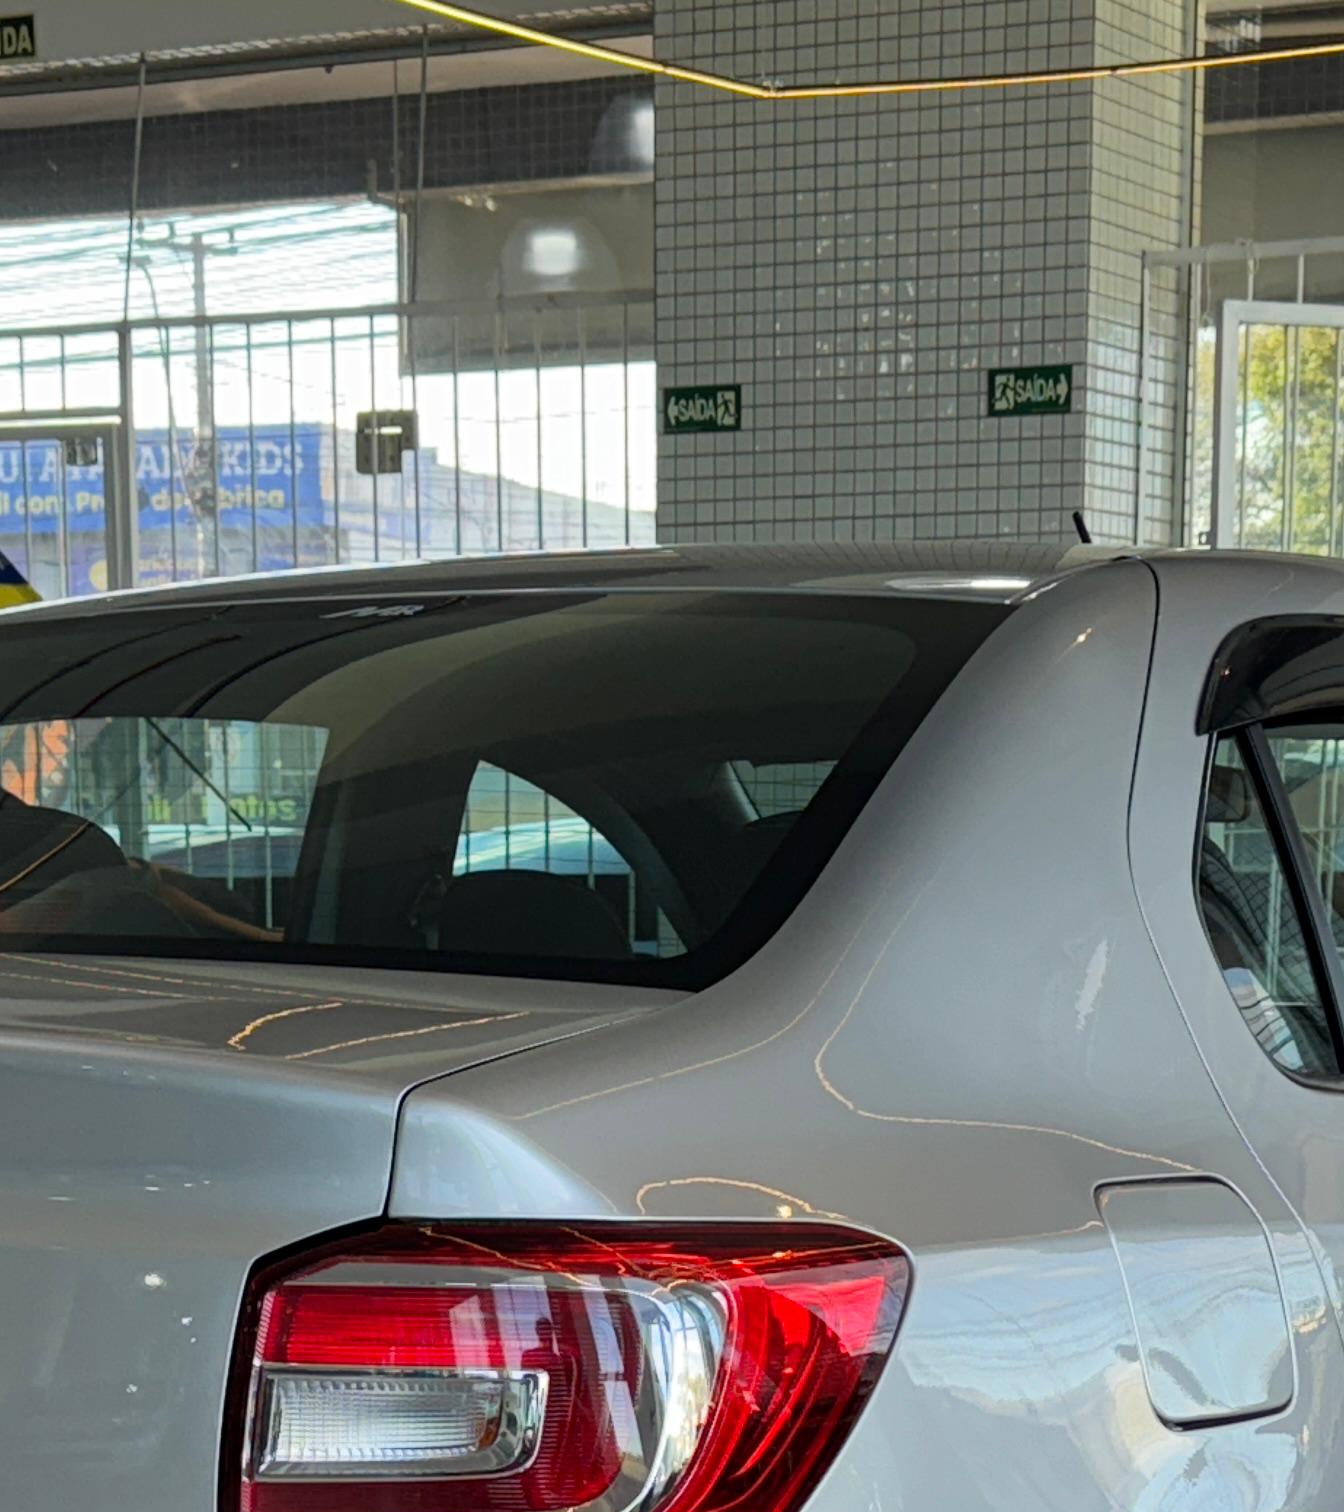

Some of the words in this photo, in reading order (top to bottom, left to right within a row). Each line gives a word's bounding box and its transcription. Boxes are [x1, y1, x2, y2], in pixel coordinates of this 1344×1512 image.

[1016, 373, 1056, 403] SAÍDA
[678, 393, 716, 422] SAÍDA
[221, 441, 304, 478] KIDS
